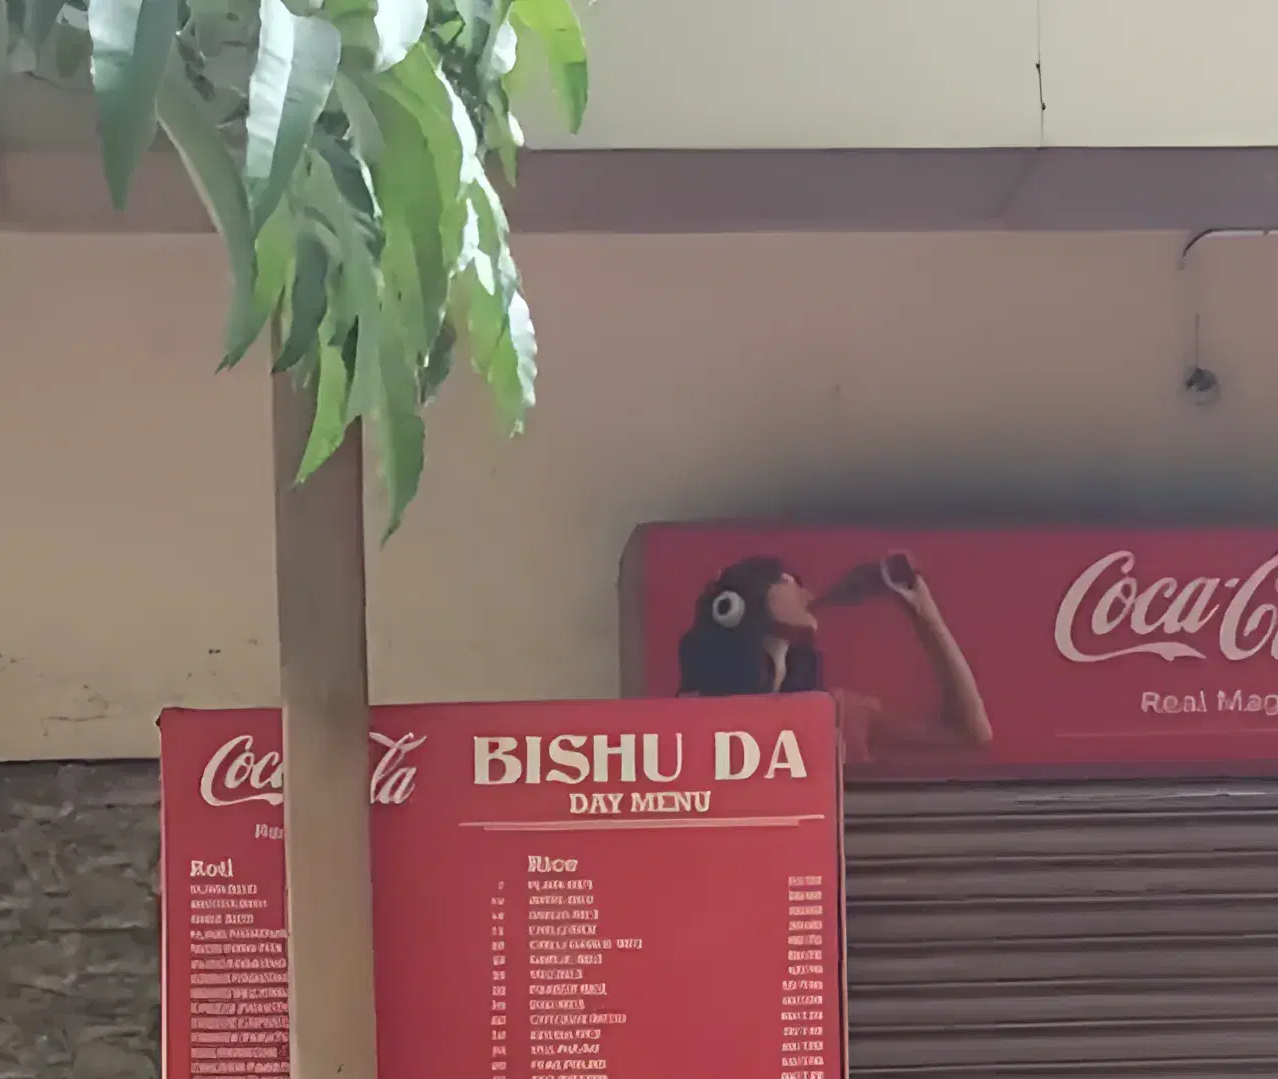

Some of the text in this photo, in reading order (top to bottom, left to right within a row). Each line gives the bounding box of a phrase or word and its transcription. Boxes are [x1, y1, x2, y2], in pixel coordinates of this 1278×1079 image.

[1141, 690, 1207, 713] Real
[473, 730, 808, 785] BISHU DA
[569, 790, 712, 814] DAY MENU
